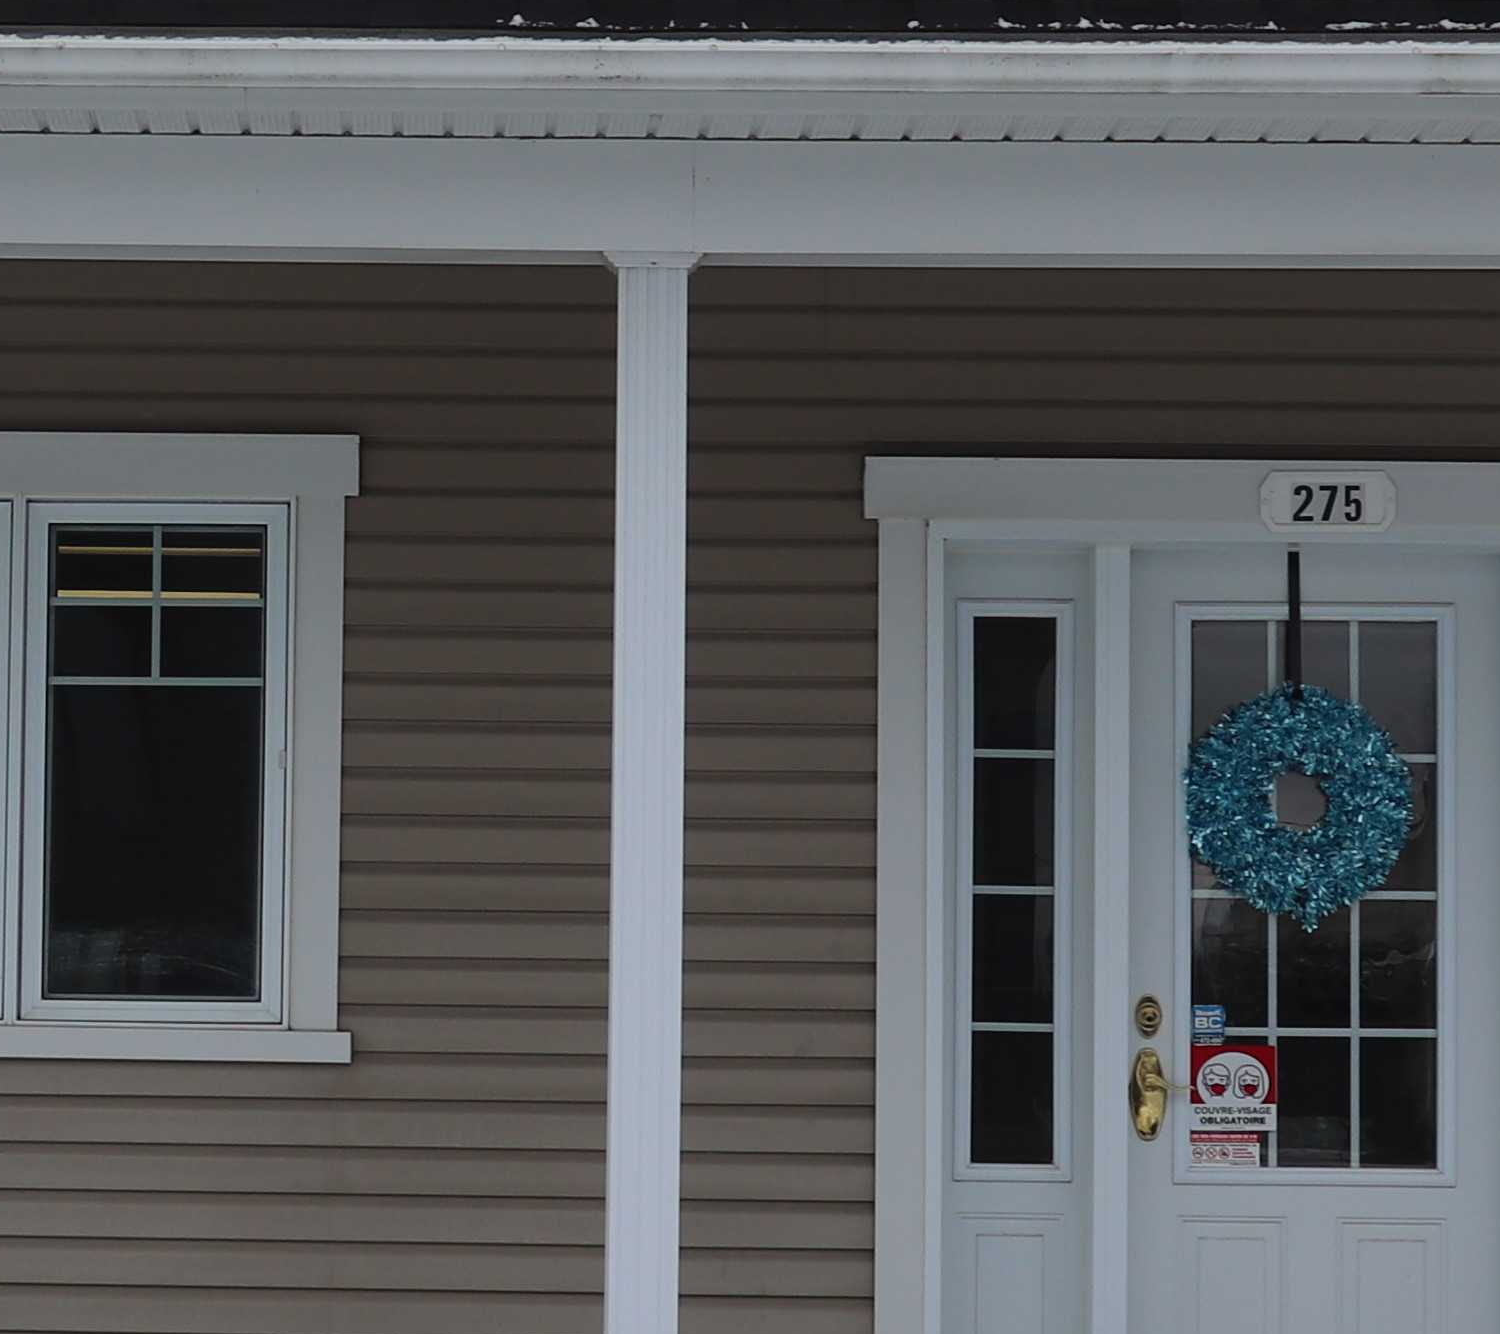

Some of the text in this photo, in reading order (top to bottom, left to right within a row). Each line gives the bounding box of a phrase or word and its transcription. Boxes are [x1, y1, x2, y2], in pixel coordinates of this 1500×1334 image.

[1291, 484, 1363, 522] 275
[1195, 1017, 1223, 1028] BC
[1193, 1106, 1273, 1115] COUVRE-VISAGE
[1200, 1116, 1267, 1125] OBLIGATOIRE
